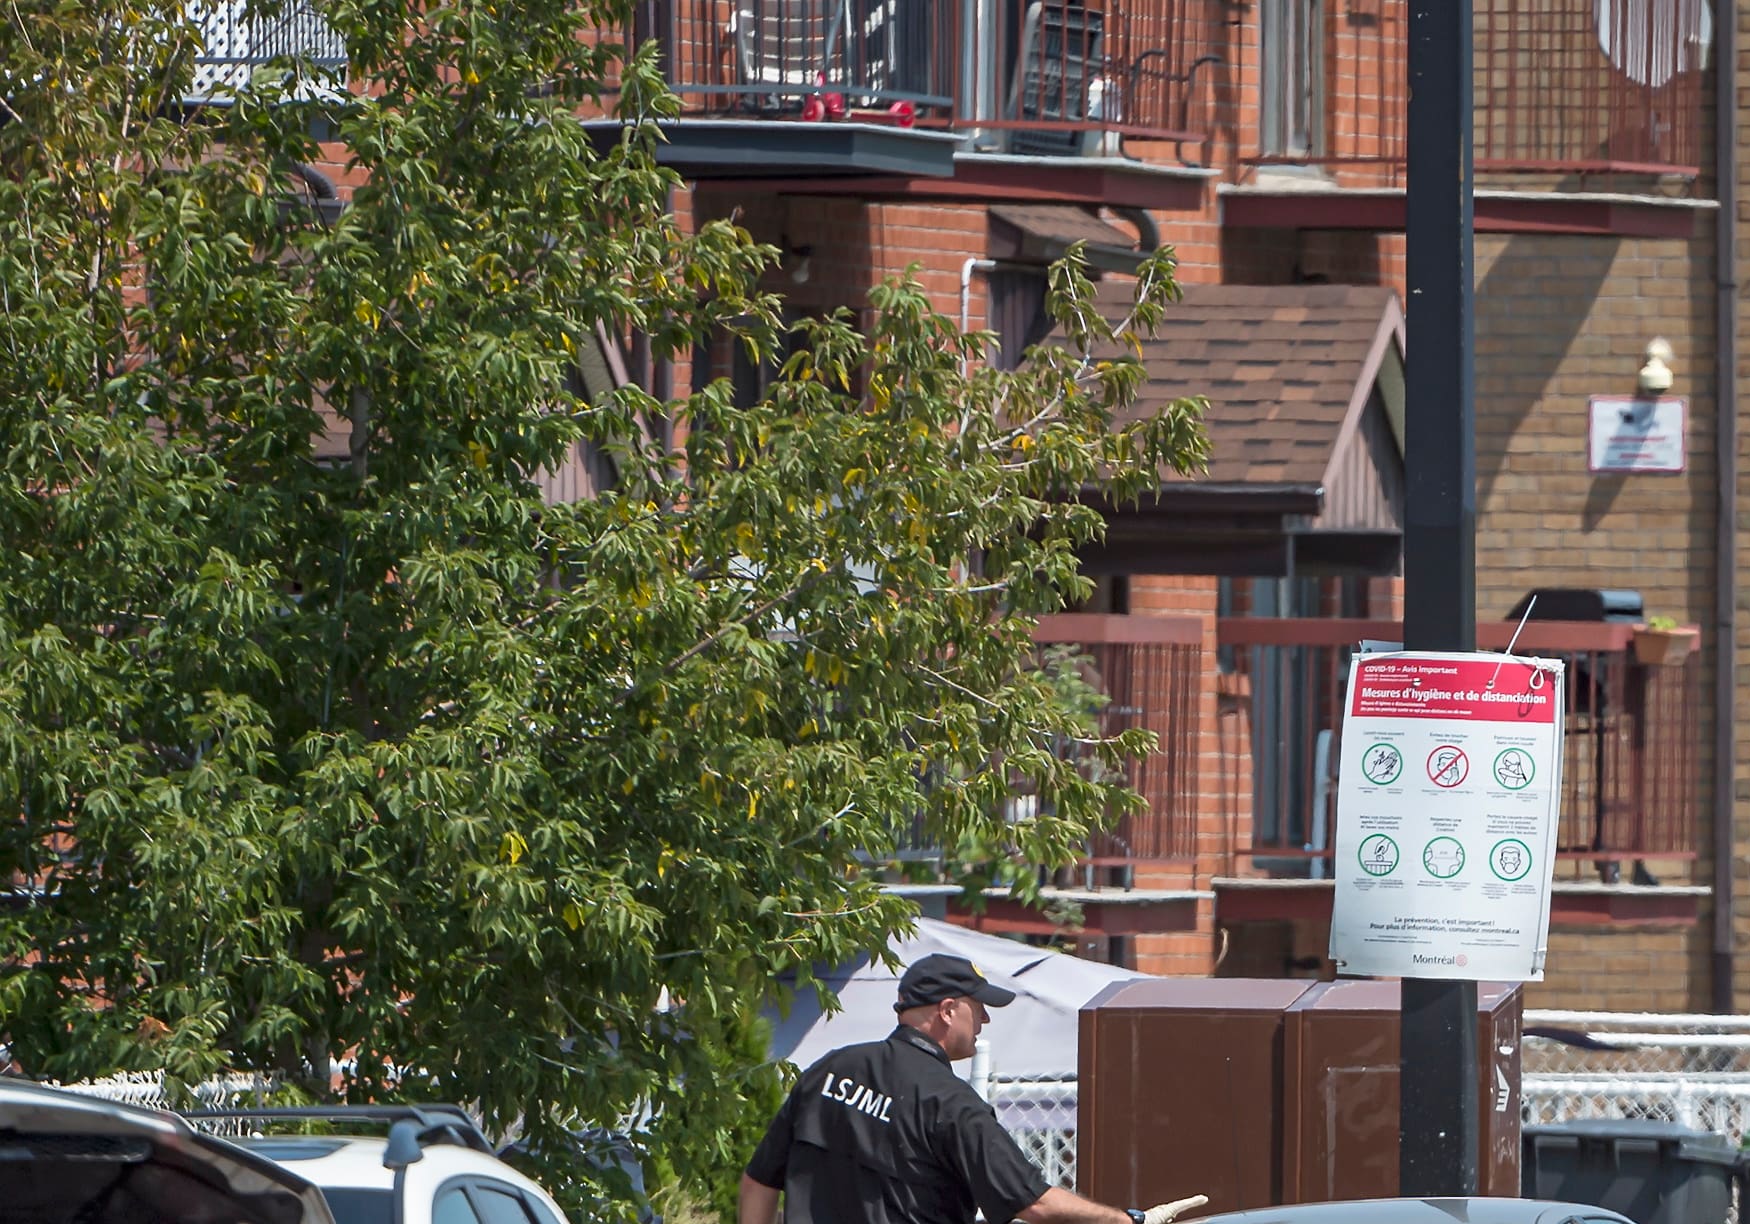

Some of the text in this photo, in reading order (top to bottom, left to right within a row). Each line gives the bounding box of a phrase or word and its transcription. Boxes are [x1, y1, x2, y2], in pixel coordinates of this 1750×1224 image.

[1364, 665, 1396, 674] COVID-19
[1402, 665, 1417, 674] Avis
[1361, 687, 1547, 704] Mesures d'hygiène et de distanciation
[1386, 922, 1400, 930] plus
[1413, 953, 1455, 965] Montréal
[820, 1072, 893, 1123] LSJML
